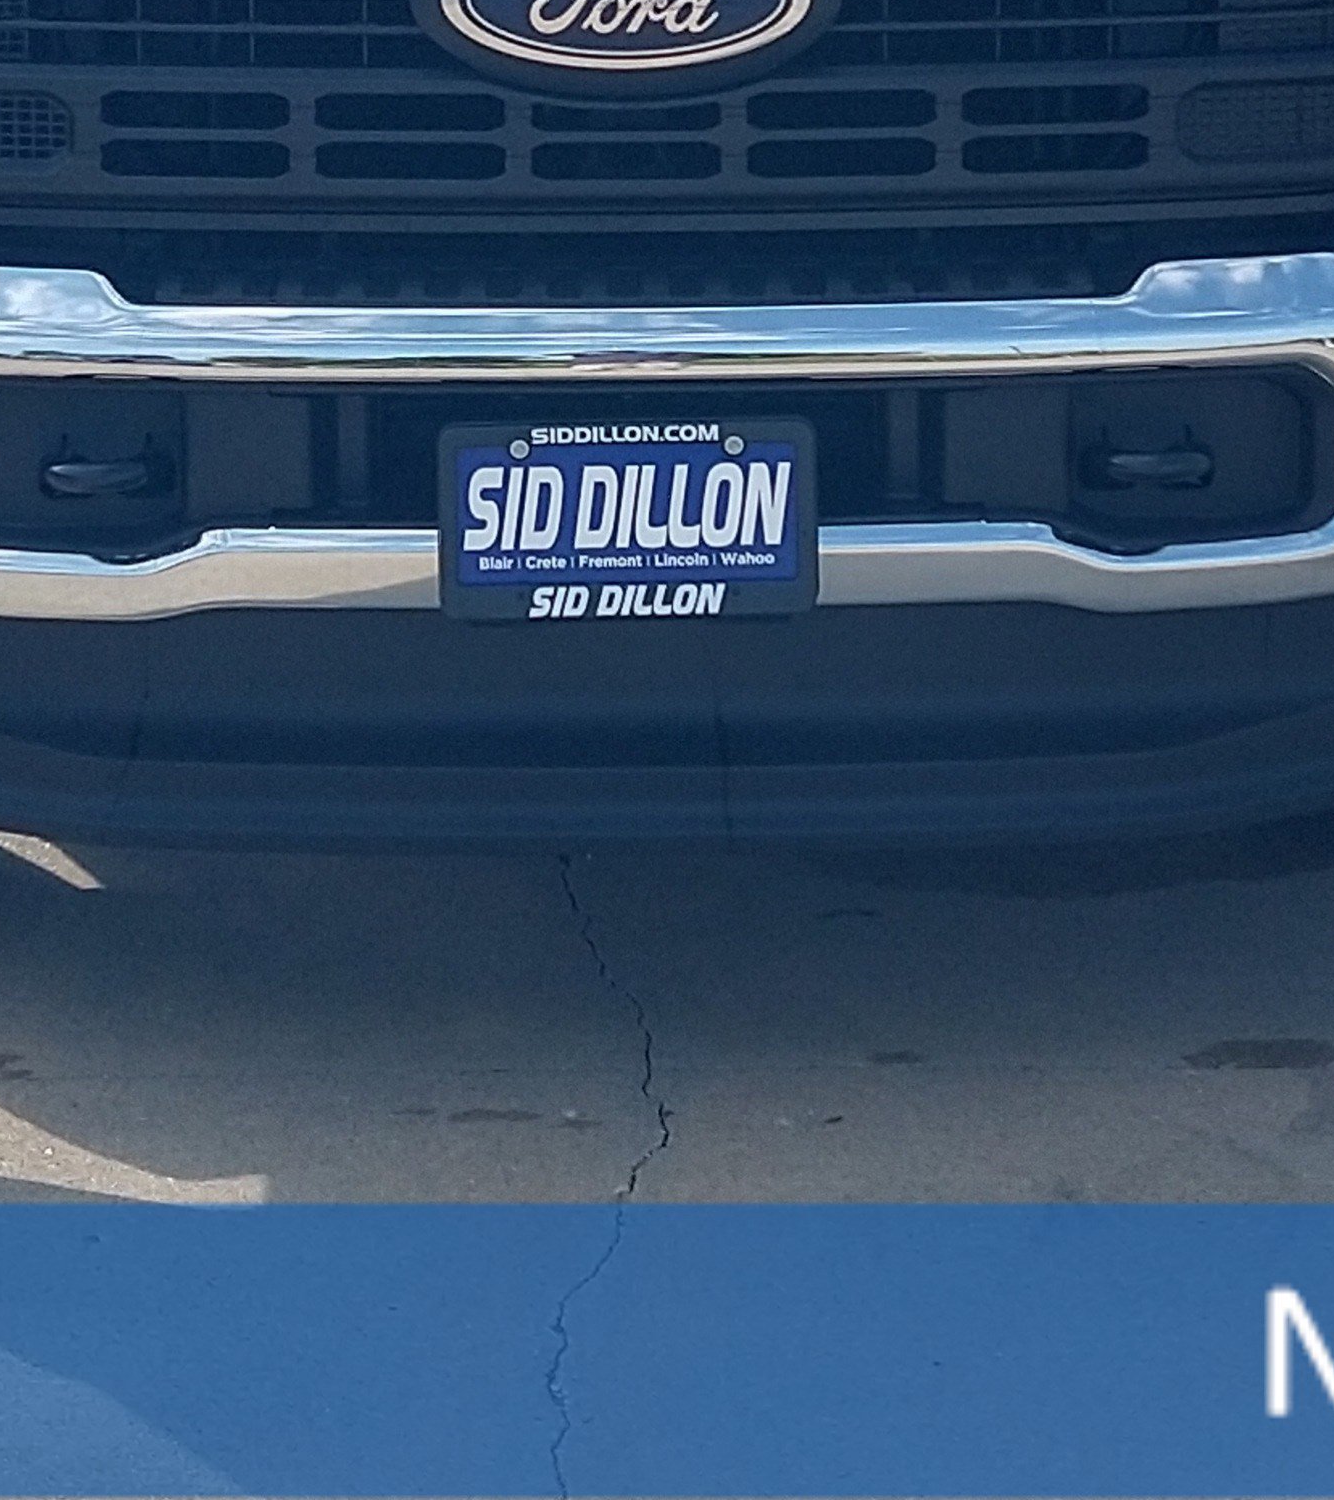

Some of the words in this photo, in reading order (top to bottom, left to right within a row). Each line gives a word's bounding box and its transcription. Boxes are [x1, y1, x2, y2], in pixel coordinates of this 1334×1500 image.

[530, 424, 719, 446] SIDDILLON.COM
[463, 465, 565, 552] SID
[573, 461, 792, 550] DILLON
[478, 556, 514, 571] Blair
[525, 555, 568, 570] Crete
[578, 553, 643, 569] Fremont
[653, 552, 710, 568] Lincoln
[720, 551, 776, 566] Wahoo
[528, 585, 590, 618] SID
[595, 582, 727, 617] DILLON
